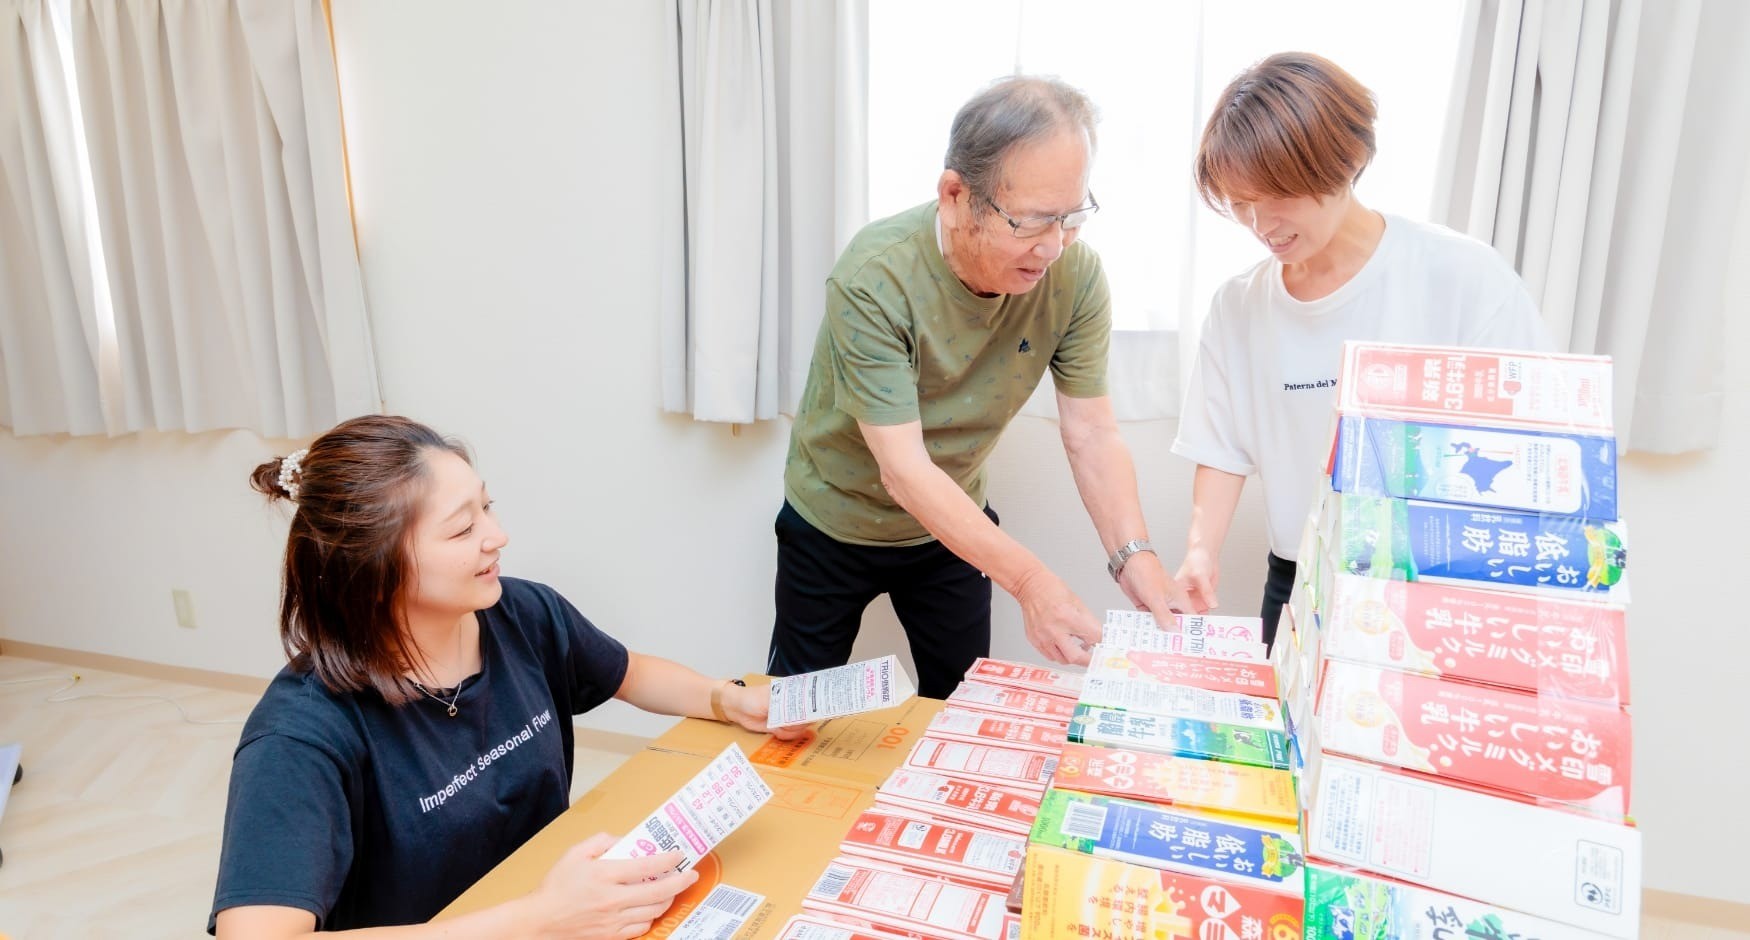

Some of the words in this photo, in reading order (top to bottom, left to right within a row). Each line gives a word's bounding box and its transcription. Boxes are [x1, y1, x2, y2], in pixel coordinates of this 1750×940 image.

[1460, 524, 1568, 560] 低脂肪
[1485, 557, 1579, 584] おいしい
[1189, 616, 1204, 635] TRIO
[1424, 606, 1599, 652] おいしい牛乳
[1436, 635, 1611, 678] 雪印メグミルク
[877, 726, 911, 751] 100
[1096, 711, 1125, 735] 酪農
[1126, 717, 1155, 739] 牛乳
[1420, 700, 1602, 758] おいしい牛乳
[418, 762, 479, 813] Imperfect
[474, 723, 534, 771] Seasonal
[530, 707, 553, 733] Flow
[1113, 753, 1130, 786] マミー
[1435, 732, 1612, 785] 雪印メグミルク
[1146, 820, 1248, 855] 低脂肪
[1168, 844, 1254, 872] おいしい
